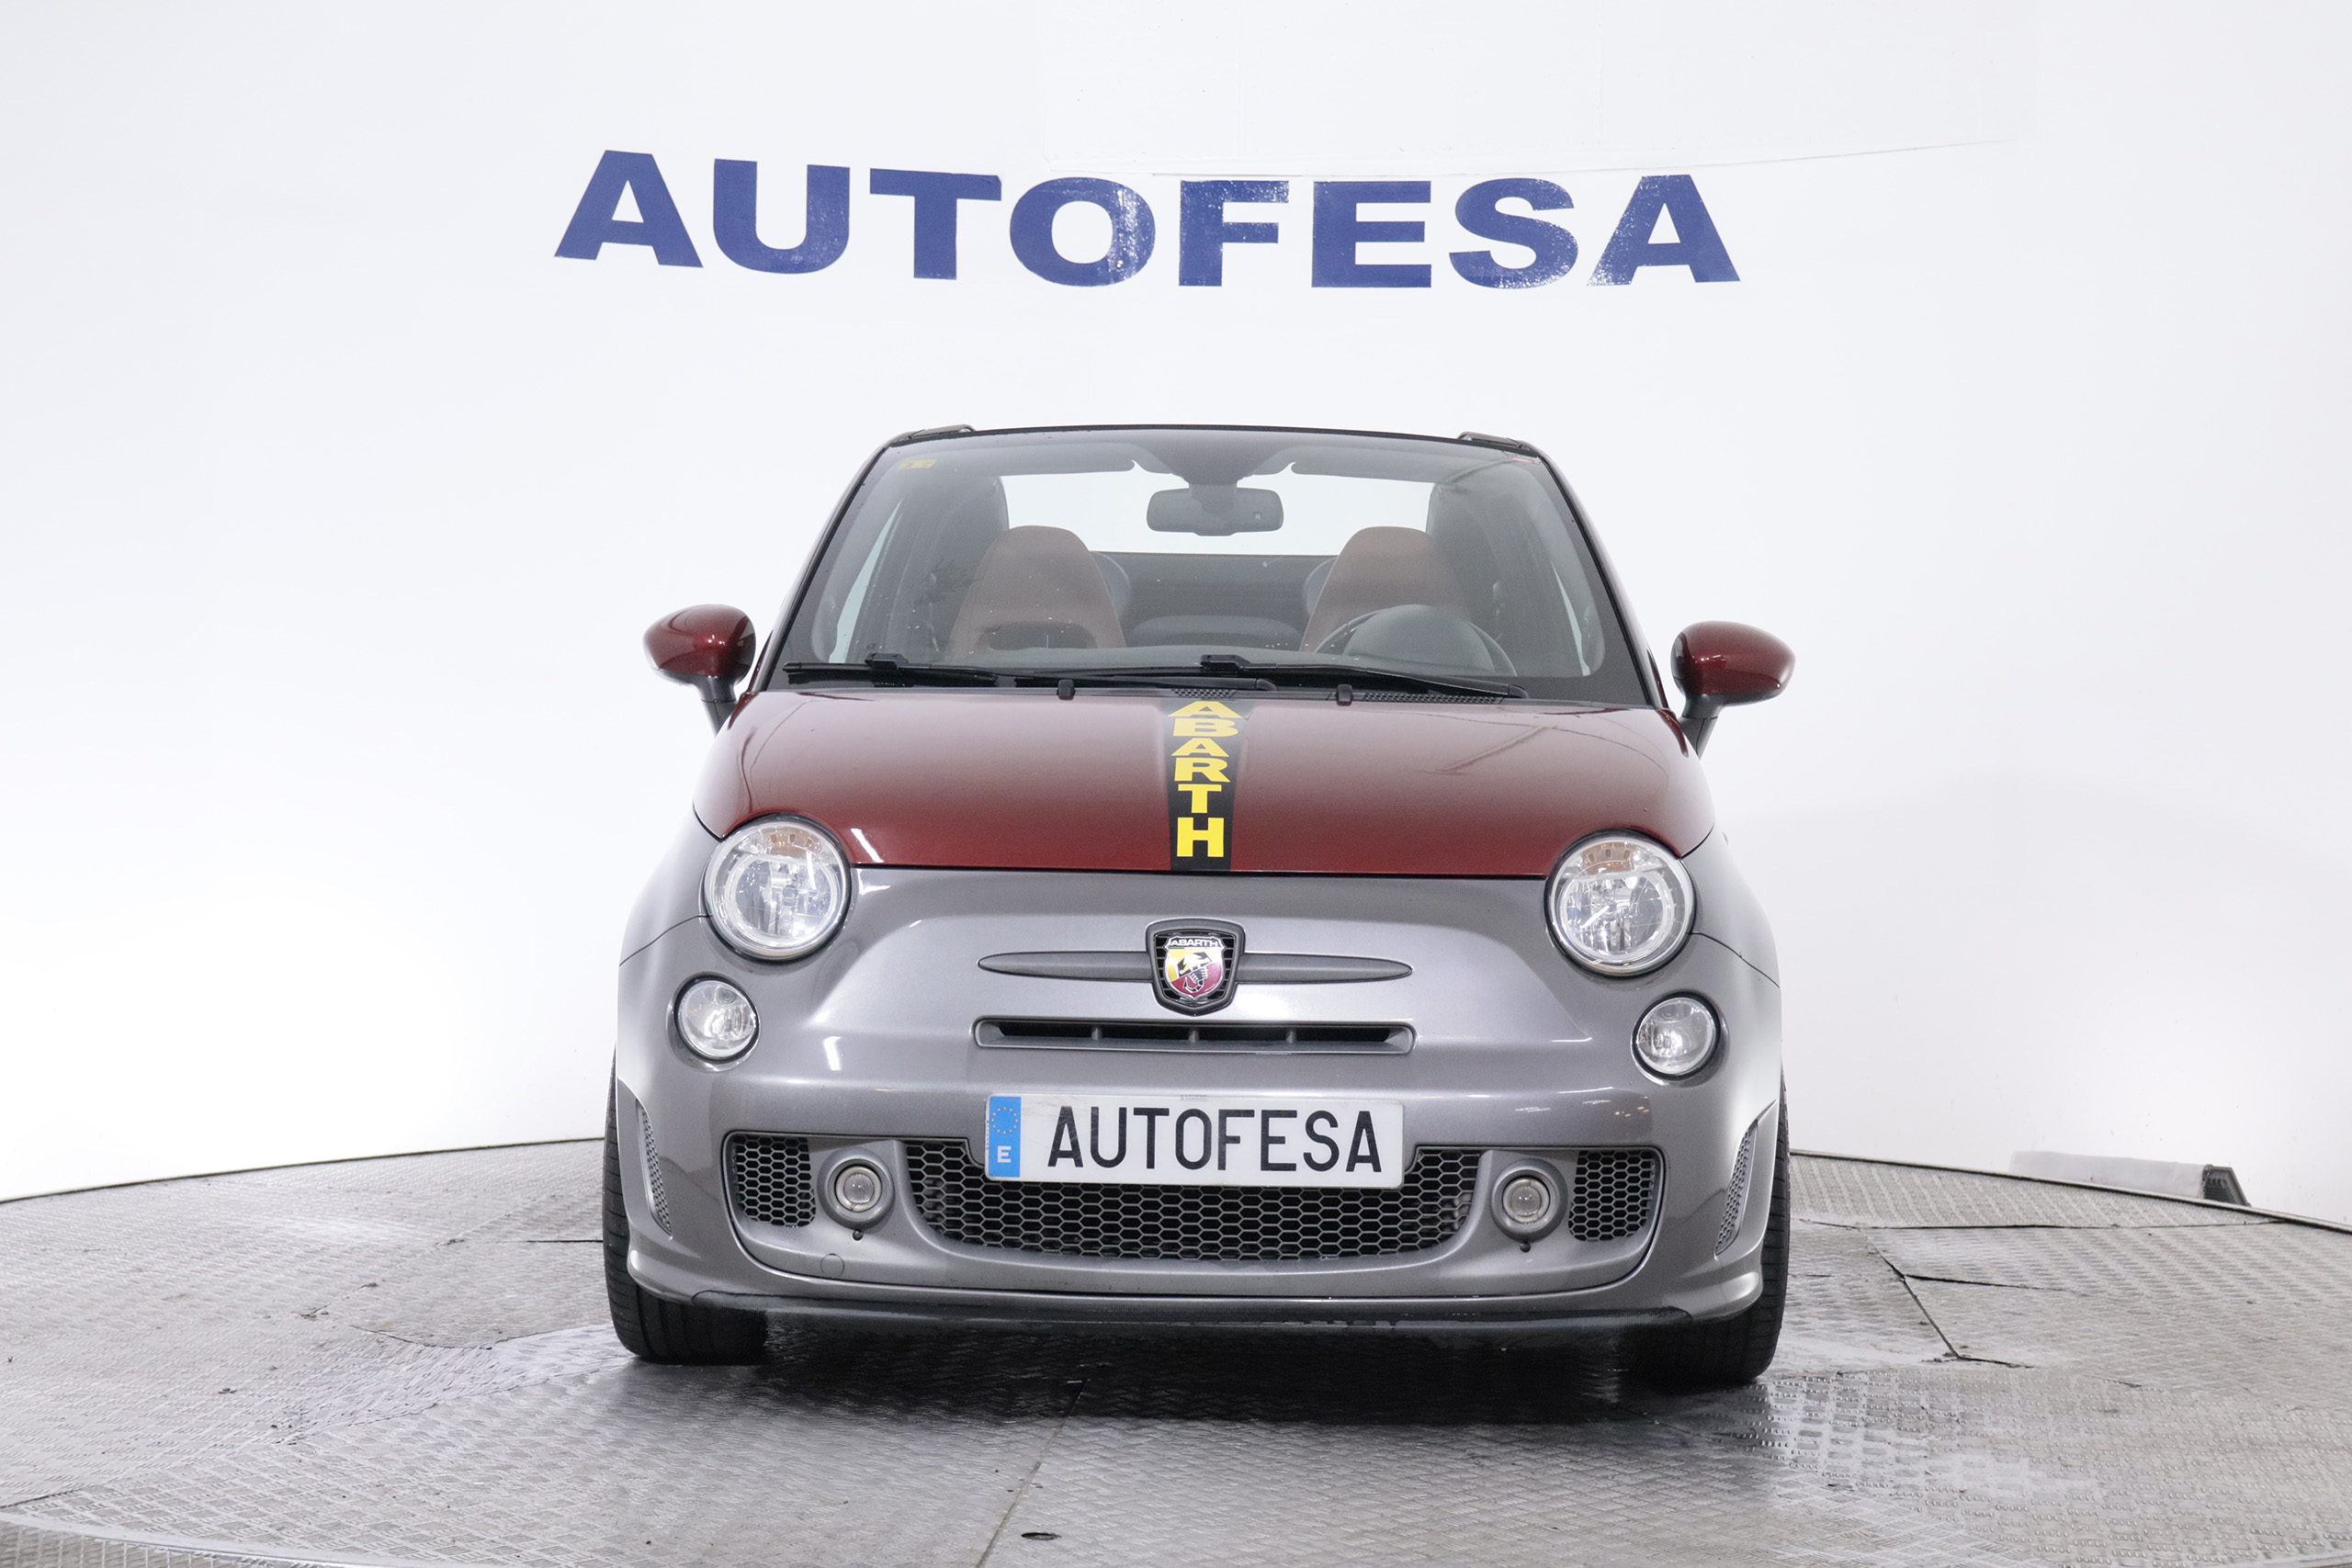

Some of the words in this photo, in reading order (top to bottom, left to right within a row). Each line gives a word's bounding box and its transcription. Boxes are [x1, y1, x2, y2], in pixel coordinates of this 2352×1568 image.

[554, 149, 1740, 288] AUTOFESA
[1168, 700, 1243, 858] ABARTH
[1170, 939, 1218, 947] ABARTH
[997, 1145, 1012, 1163] E
[1047, 1106, 1382, 1172] AUTOFESA
